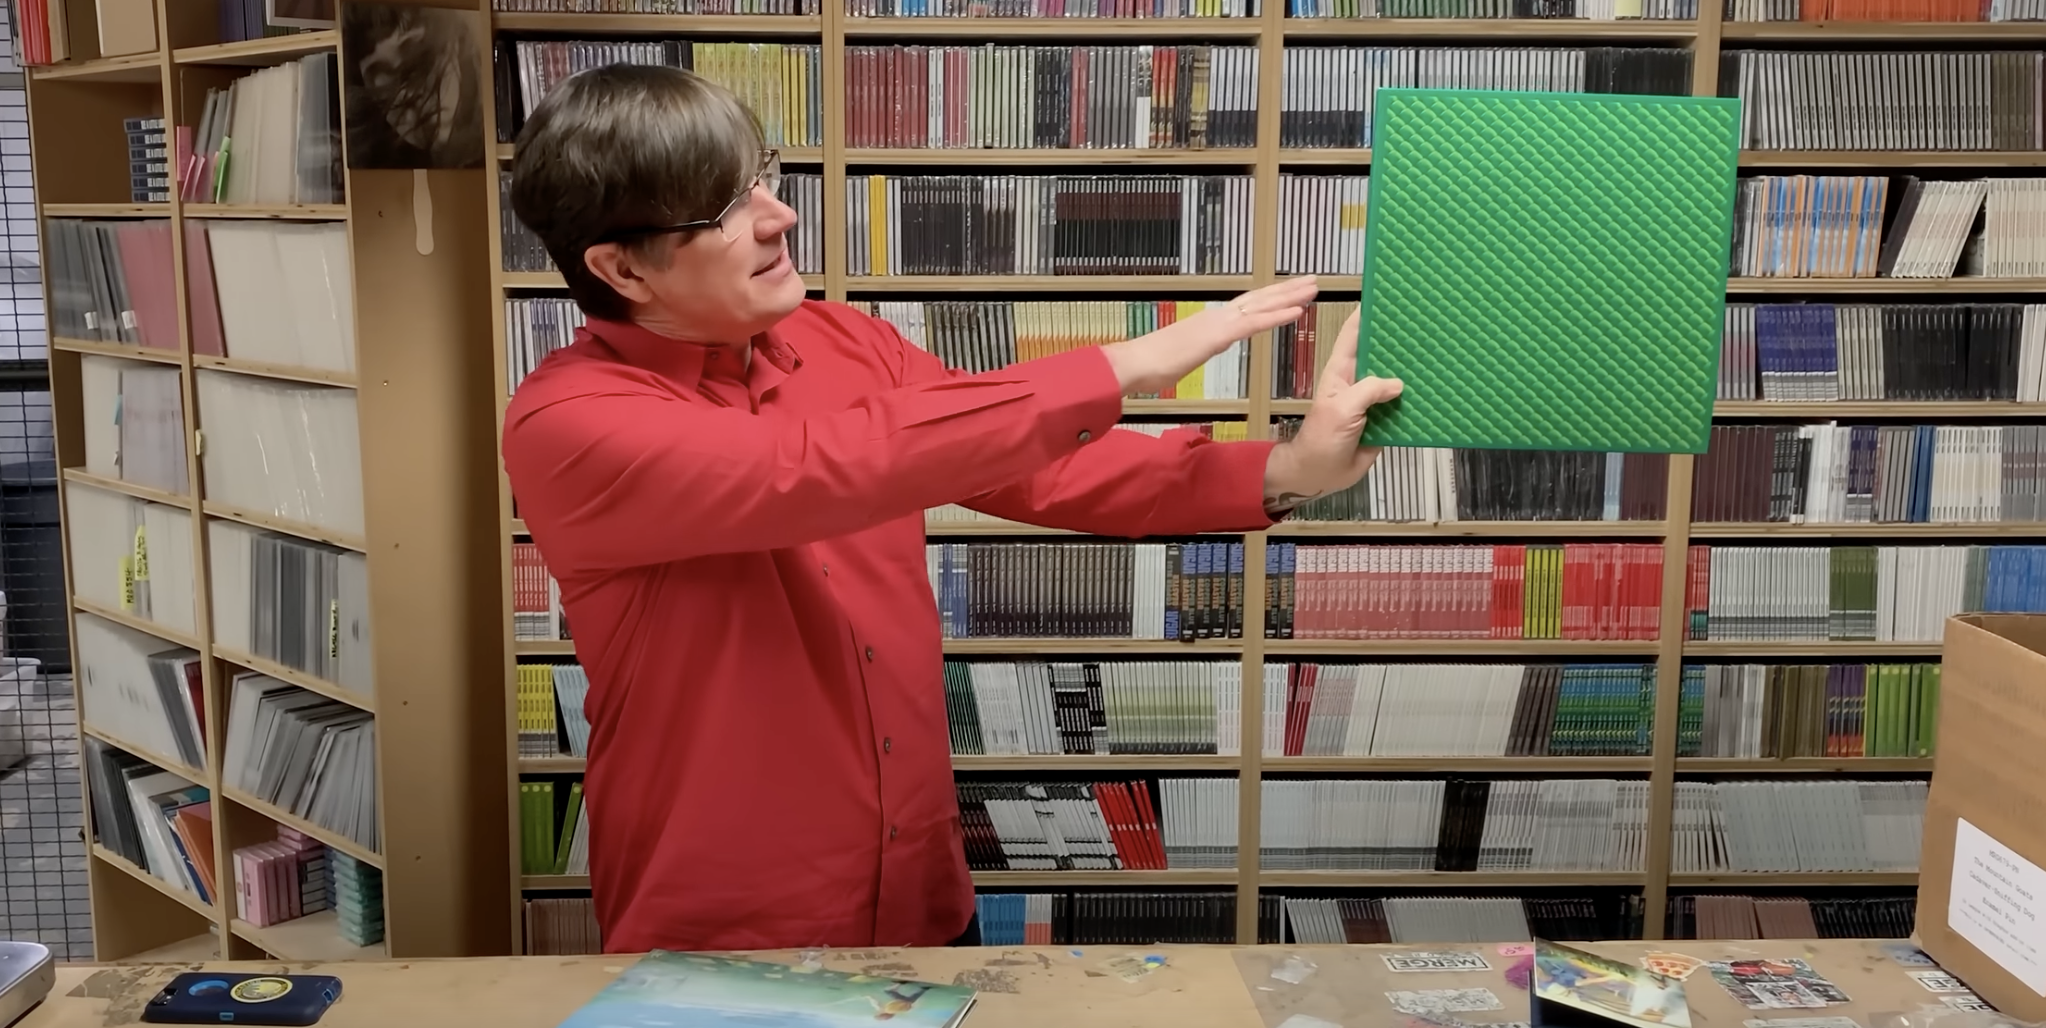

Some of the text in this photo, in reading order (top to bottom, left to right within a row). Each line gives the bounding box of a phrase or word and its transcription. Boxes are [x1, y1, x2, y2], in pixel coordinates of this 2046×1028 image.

[1183, 544, 1197, 574] SUGAR
[1198, 544, 1212, 573] SUGAR
[1212, 544, 1226, 573] SUGAR
[1230, 544, 1244, 573] SUGAR
[1266, 545, 1279, 574] SUGAR
[1281, 544, 1294, 573] SUGAR
[1296, 549, 1306, 573] SUGAR
[1306, 549, 1316, 573] SUGAR
[1317, 549, 1326, 573] SUGAR
[1328, 549, 1337, 573] SUGAR
[1338, 548, 1348, 572] SUGAR
[1348, 548, 1358, 572] SUGAR
[1359, 548, 1368, 572] SUGAR
[1369, 549, 1379, 573] SUGAR
[1380, 549, 1390, 573] SUGAR
[1390, 549, 1400, 573] SUGAR
[1401, 549, 1411, 573] SUGAR
[1412, 549, 1421, 573] SUGAR
[1423, 549, 1432, 573] SUGAR
[1433, 549, 1443, 573] SUGAR
[1443, 549, 1453, 573] SUGAR
[1454, 549, 1463, 573] SUGAR
[1463, 549, 1473, 573] SUGAR
[1473, 549, 1484, 573] SUGAR
[1484, 549, 1493, 573] SUGAR
[1212, 577, 1220, 610] BEASTER
[1166, 611, 1179, 639] SUGAR
[1974, 856, 2033, 901] The Mountain Goats
[1969, 870, 2021, 912] Cadaver-Sniffing
[2024, 907, 2035, 922] Dog
[1982, 897, 2002, 915] Enamel
[2005, 912, 2016, 925] Pin
[1399, 958, 1478, 968] MERGE
